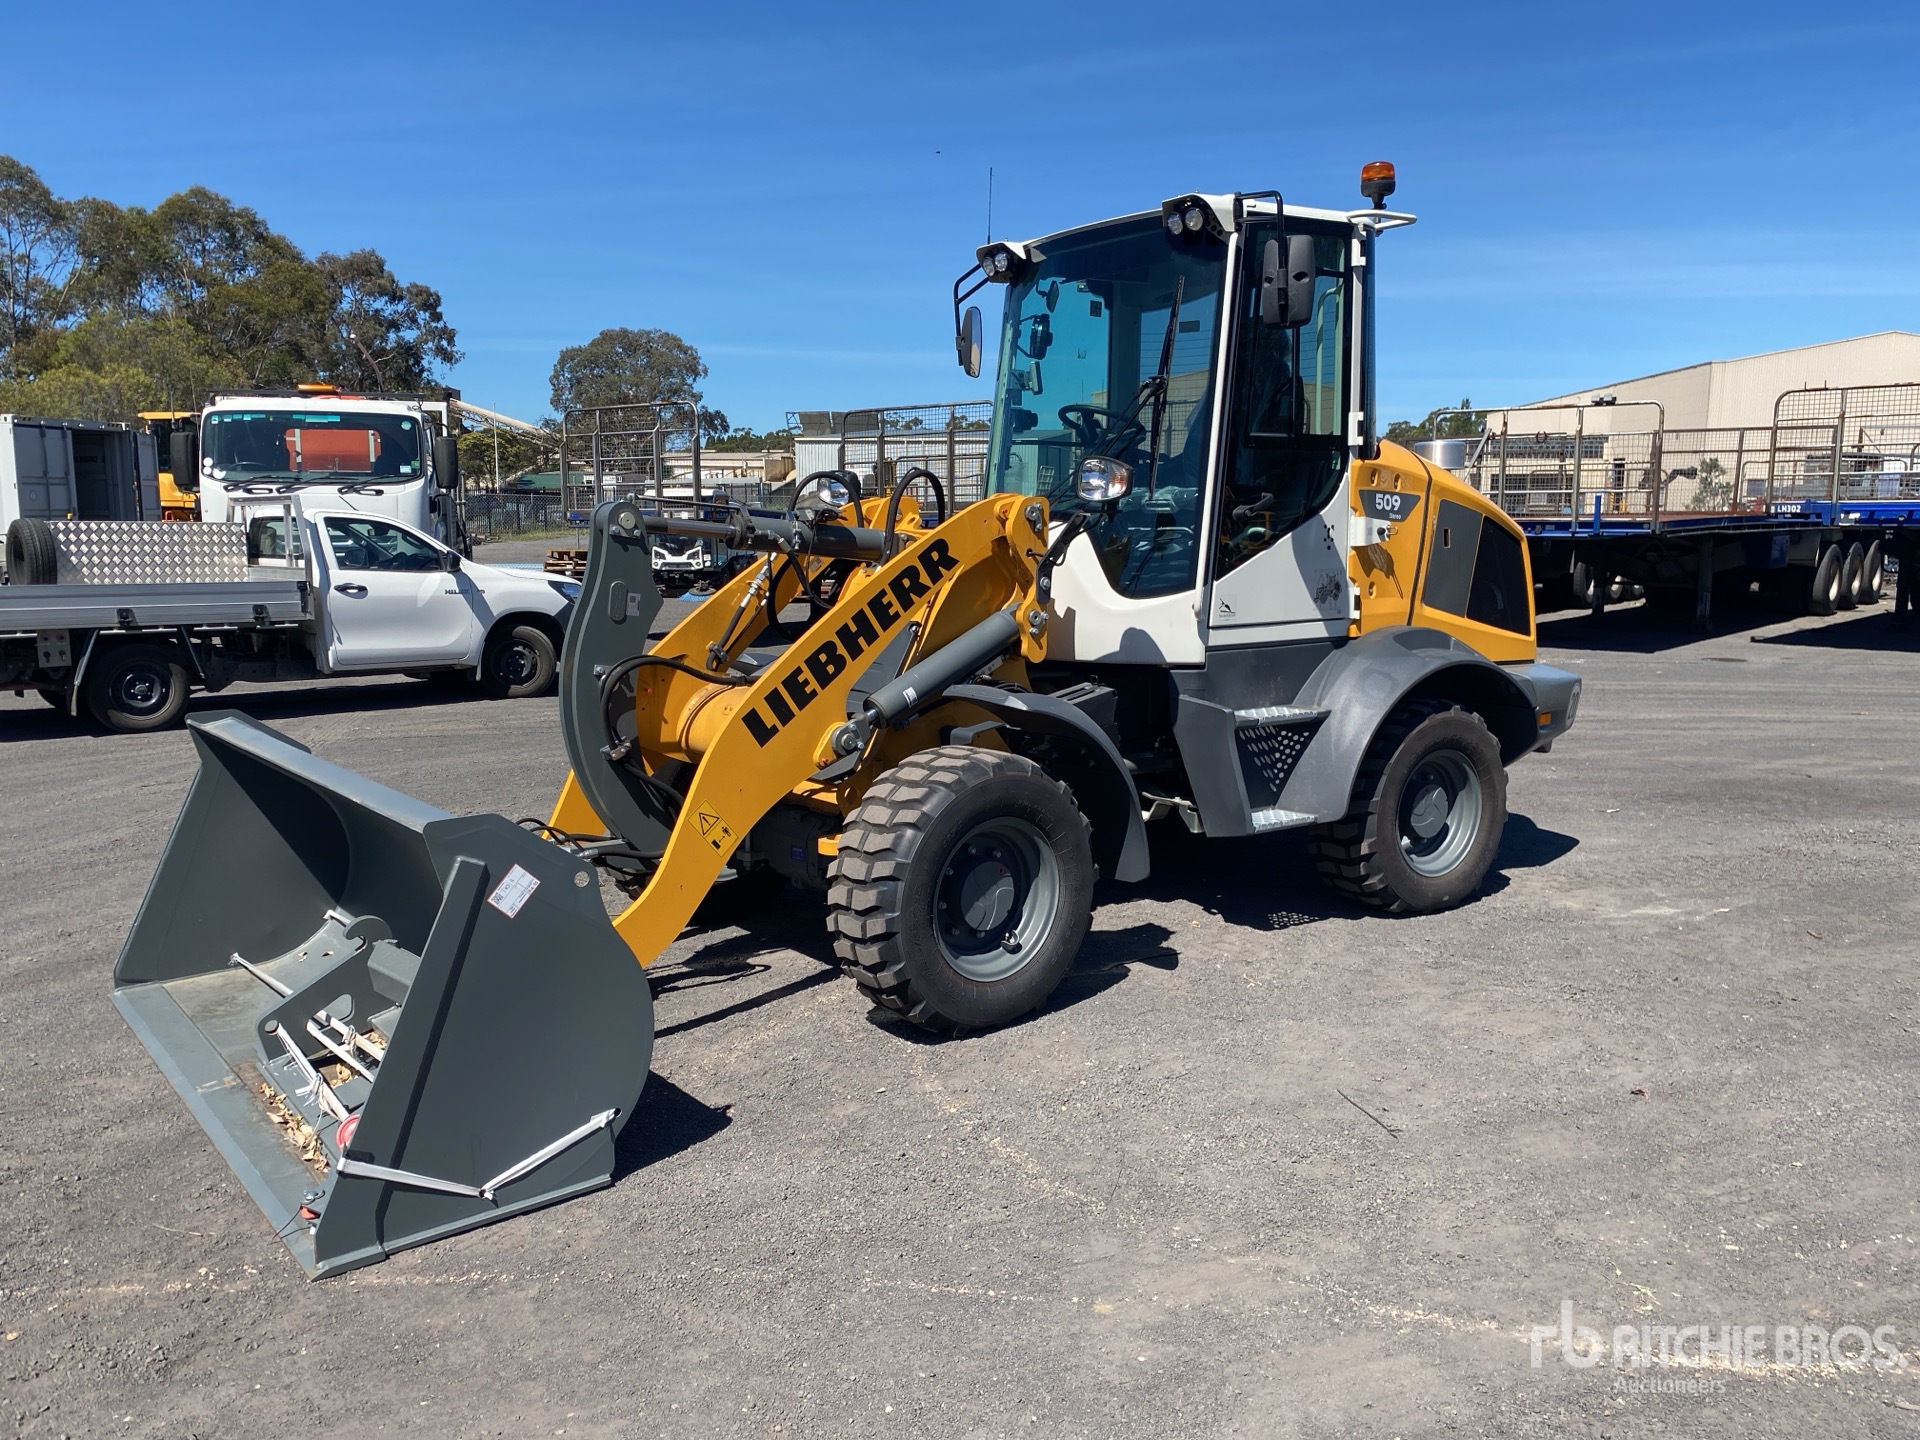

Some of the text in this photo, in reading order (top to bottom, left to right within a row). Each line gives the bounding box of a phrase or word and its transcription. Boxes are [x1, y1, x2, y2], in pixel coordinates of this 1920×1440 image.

[1375, 493, 1401, 511] 509
[1777, 505, 1802, 513] LH302
[741, 538, 960, 748] LIEBHERR
